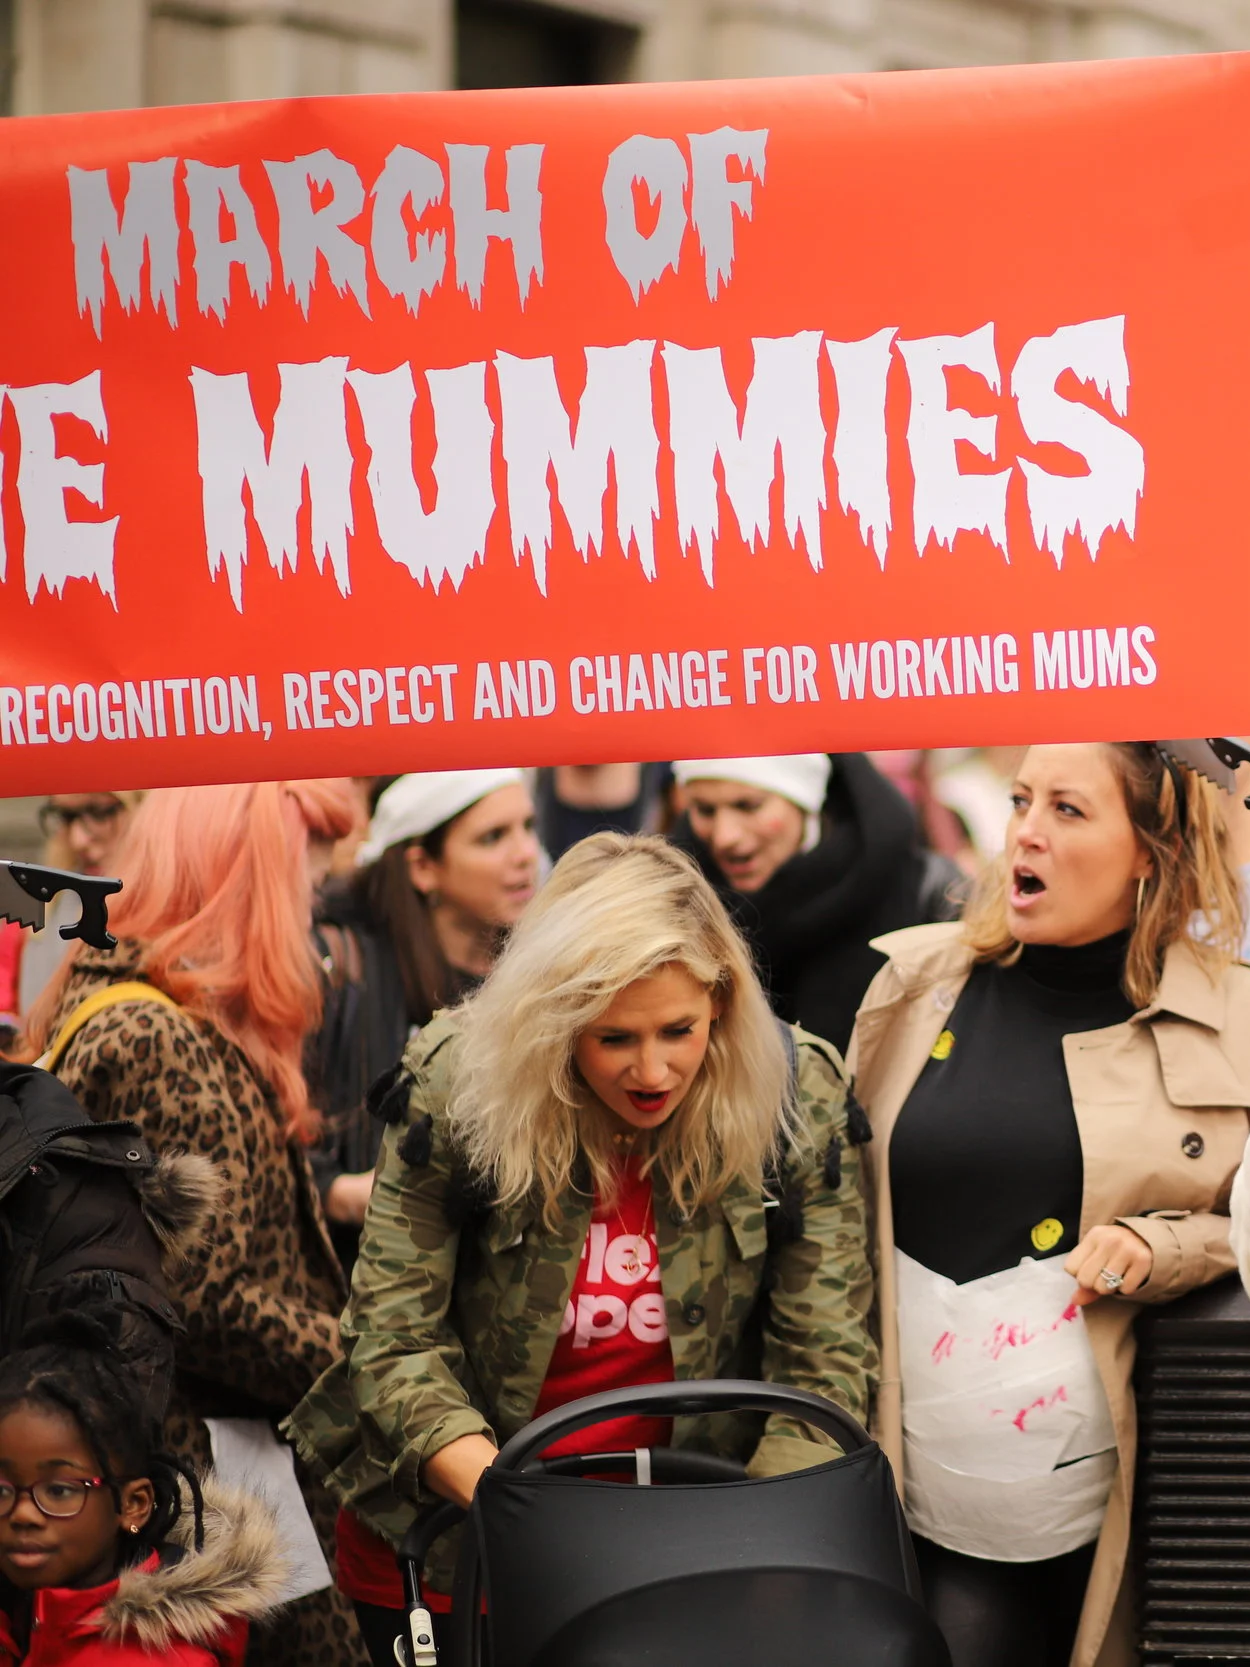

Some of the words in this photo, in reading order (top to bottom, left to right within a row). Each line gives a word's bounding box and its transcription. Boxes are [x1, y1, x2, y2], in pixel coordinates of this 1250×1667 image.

[67, 144, 546, 341] MARCH
[602, 126, 769, 307] OF
[0, 369, 120, 613] E
[189, 314, 1145, 614] MUMMIES
[0, 674, 273, 746] RECOGNITION,
[286, 664, 459, 731] RESPECT
[473, 660, 556, 720] AND
[573, 649, 732, 715] CHANGE
[744, 646, 820, 704] FOR
[830, 633, 1019, 700] WORKING
[1032, 625, 1157, 692] MUMS
